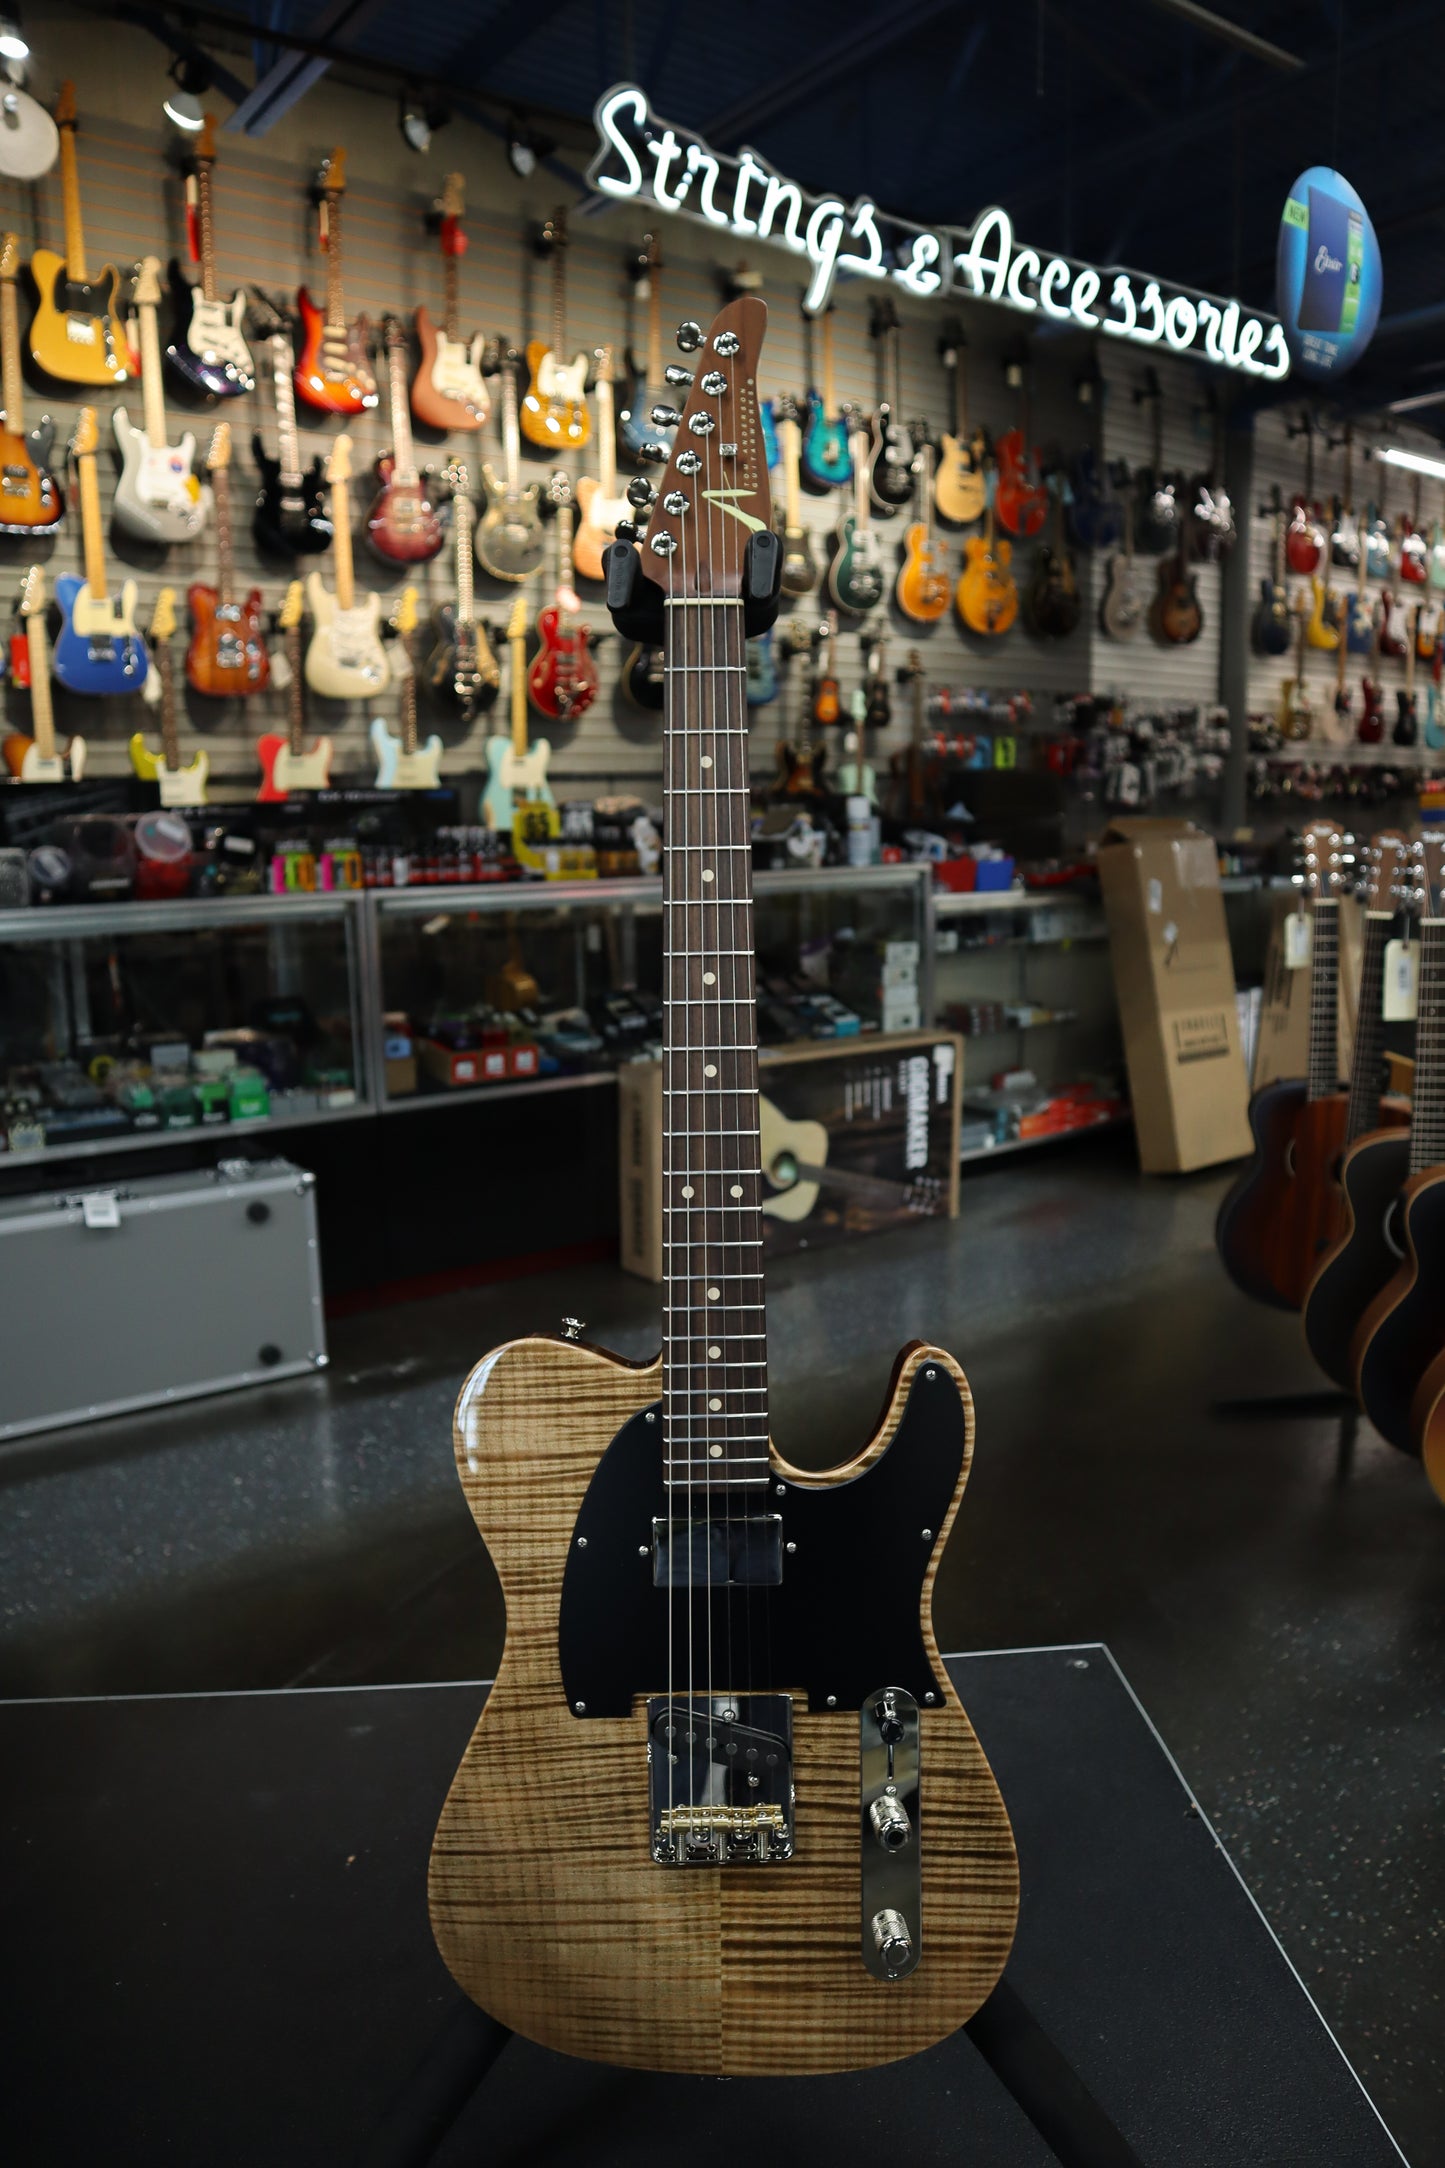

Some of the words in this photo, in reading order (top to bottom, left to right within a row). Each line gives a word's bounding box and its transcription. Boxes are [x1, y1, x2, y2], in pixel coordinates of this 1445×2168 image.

[598, 89, 888, 310] Strings
[893, 233, 941, 296] &
[953, 208, 1290, 379] Accessories
[1289, 205, 1306, 223] NEW
[740, 388, 748, 454] ANDERSON
